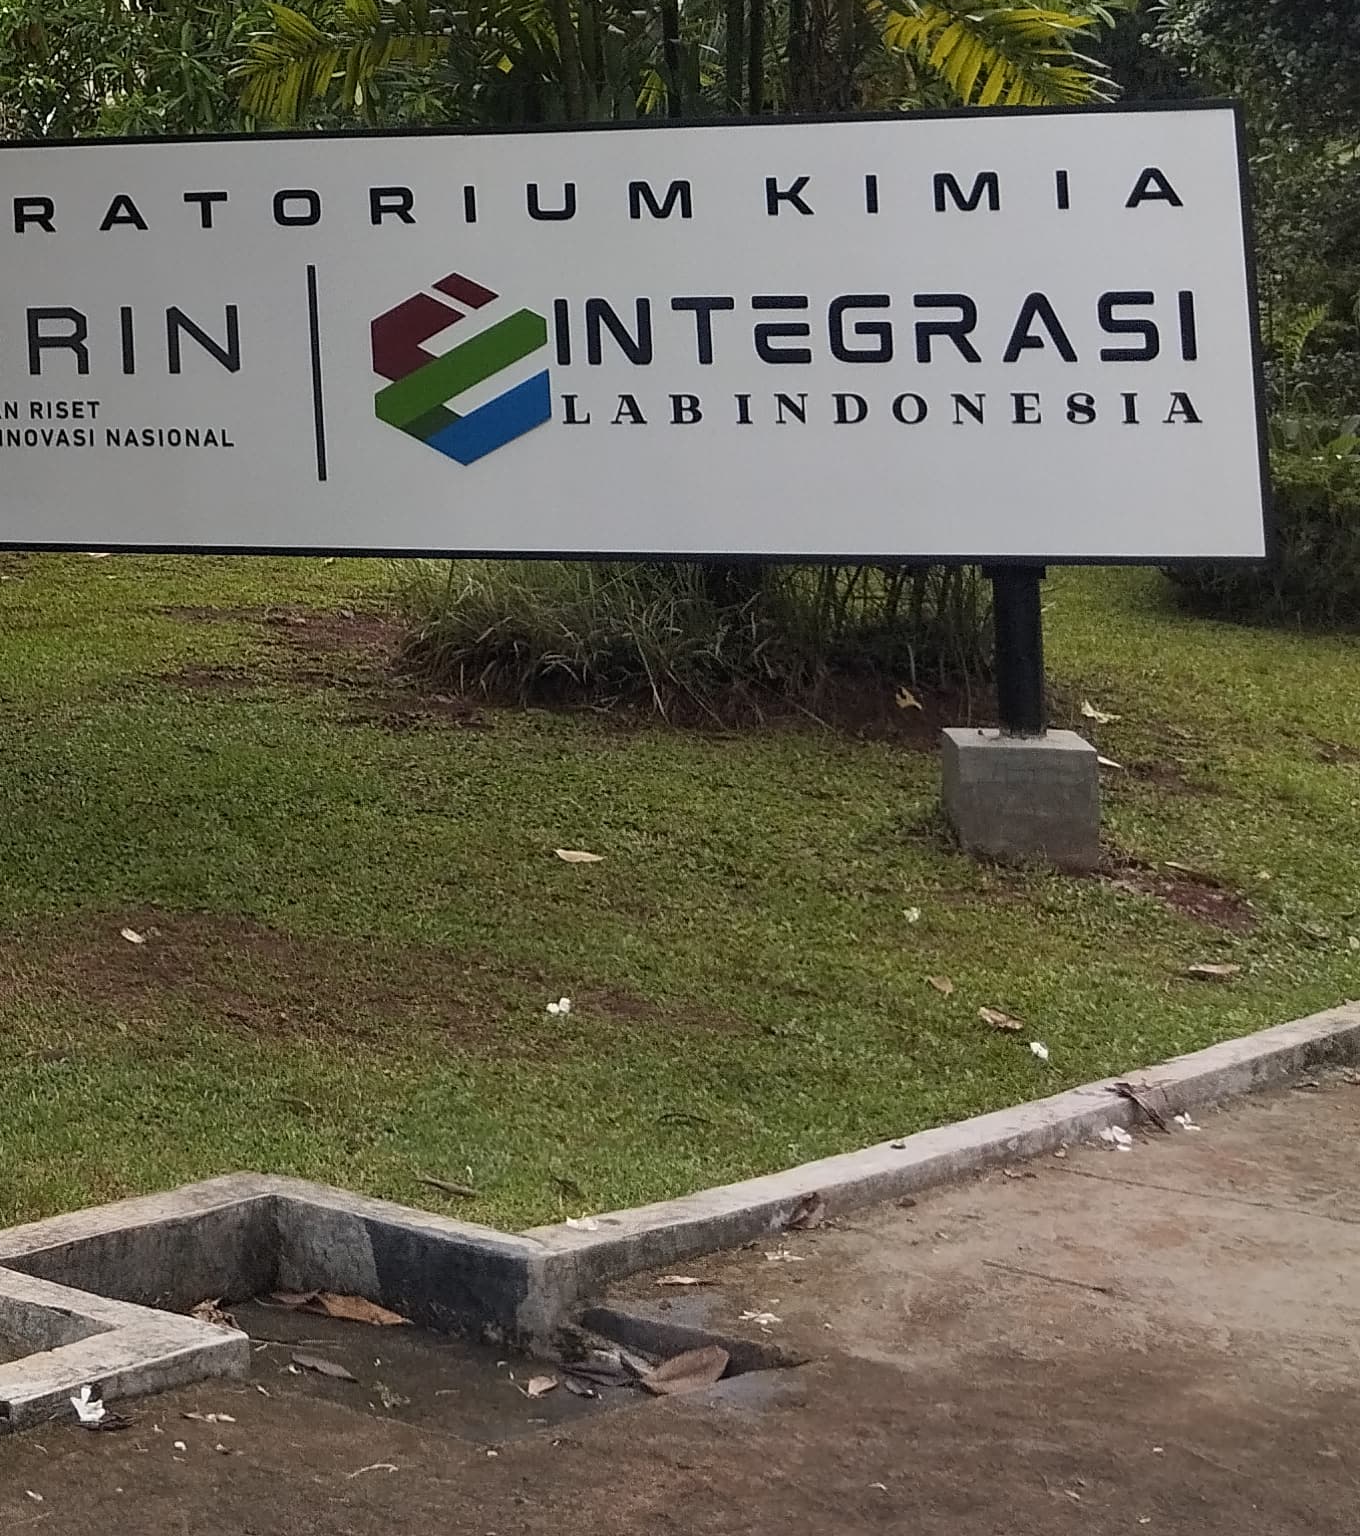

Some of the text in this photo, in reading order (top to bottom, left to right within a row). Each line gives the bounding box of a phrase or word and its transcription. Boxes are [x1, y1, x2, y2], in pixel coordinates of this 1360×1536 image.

[765, 167, 1184, 217] KIMIA
[553, 290, 1198, 366] INTEGRASI
[29, 400, 101, 420] RISET
[560, 391, 1203, 425] LAB INDONESIA
[105, 428, 235, 448] NASIONAL
